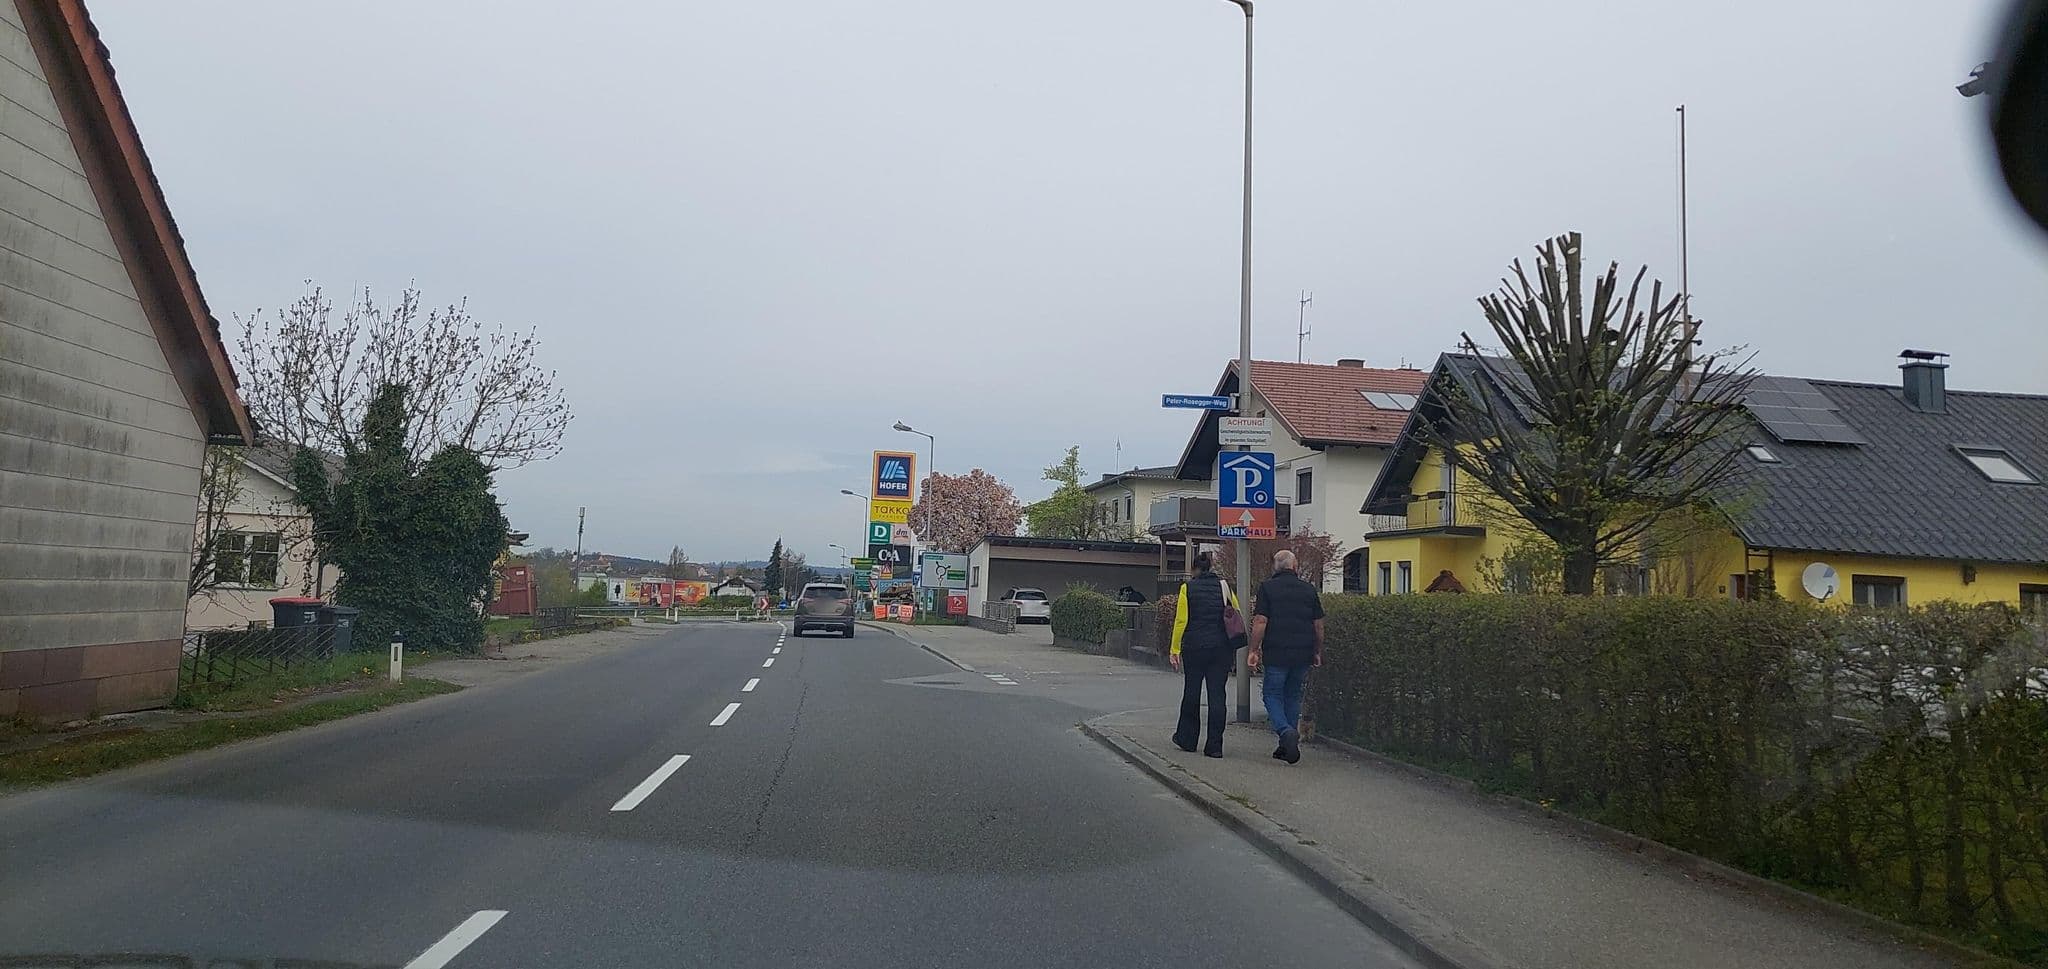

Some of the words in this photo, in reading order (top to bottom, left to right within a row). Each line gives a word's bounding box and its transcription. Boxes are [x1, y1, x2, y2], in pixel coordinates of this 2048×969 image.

[1165, 397, 1227, 407] Peter-Rosegger-Weg
[1227, 418, 1265, 426] ACHTUNG!
[879, 482, 907, 491] HOFER
[874, 525, 887, 538] D
[896, 528, 908, 536] dm
[1221, 527, 1272, 536] PARKHAUS
[878, 549, 900, 562] C&A
